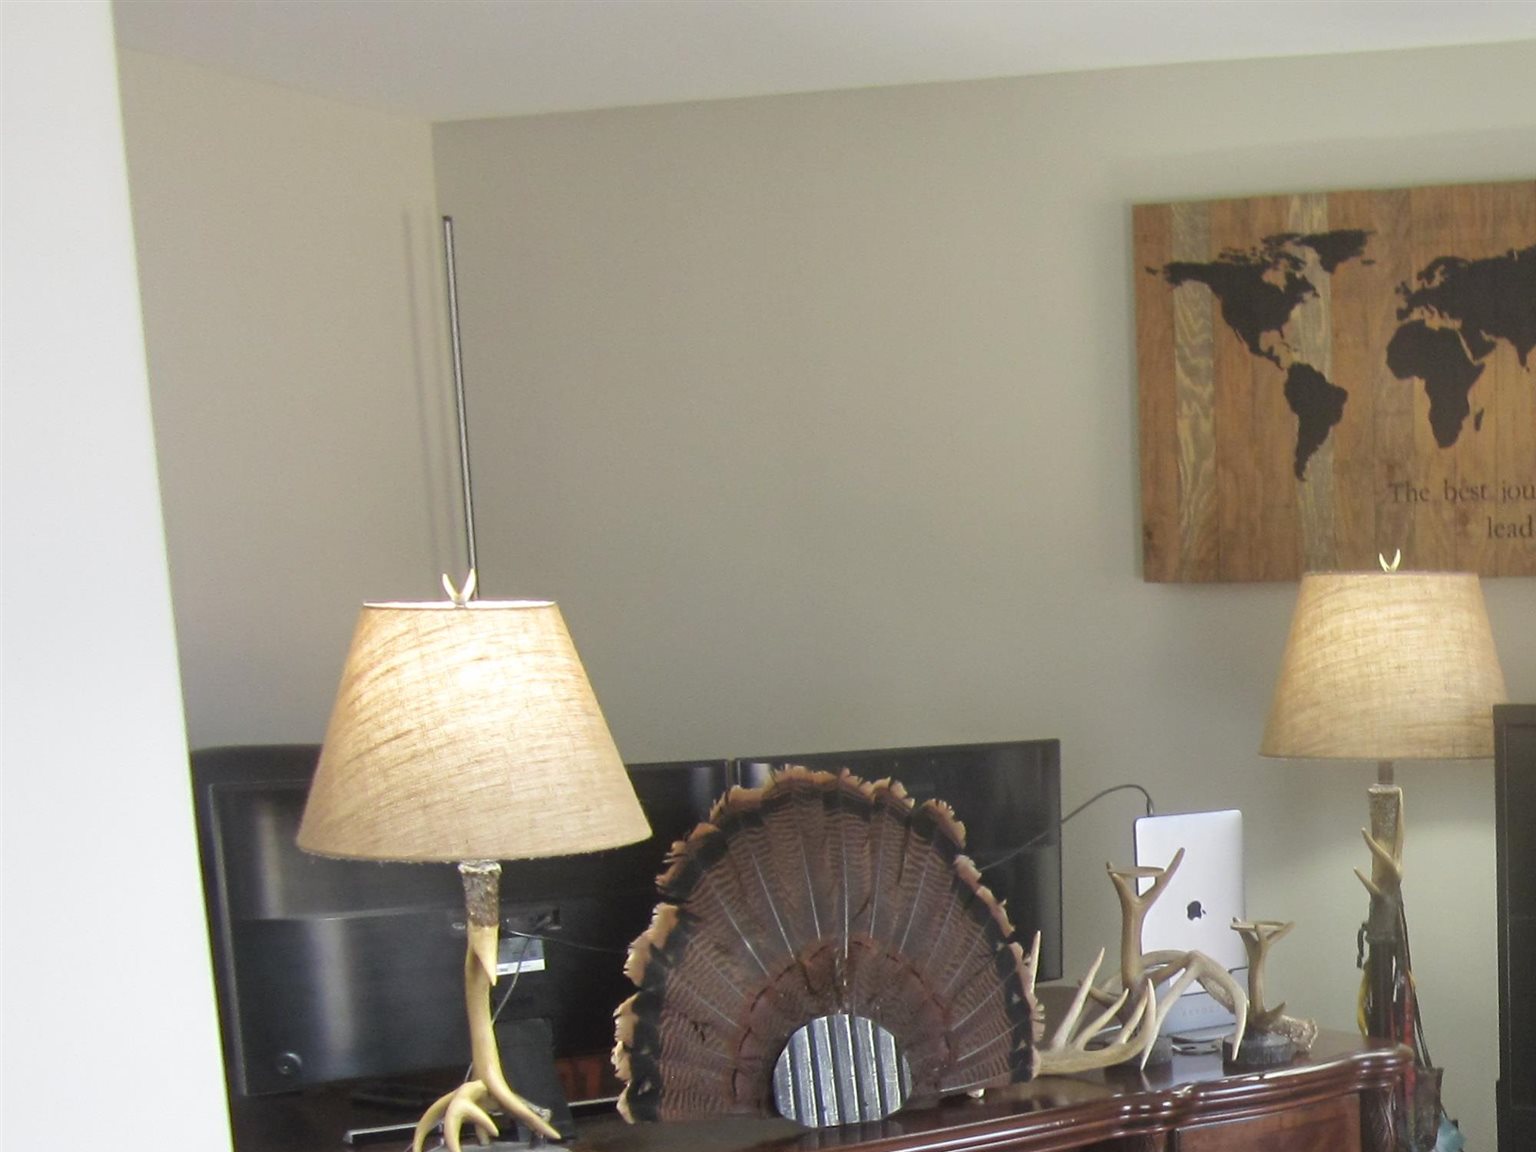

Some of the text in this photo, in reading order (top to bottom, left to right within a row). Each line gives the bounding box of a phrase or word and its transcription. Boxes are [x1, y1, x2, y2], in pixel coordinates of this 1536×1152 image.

[1388, 480, 1430, 502] The
[1443, 479, 1487, 501] best
[1487, 514, 1533, 538] lead
